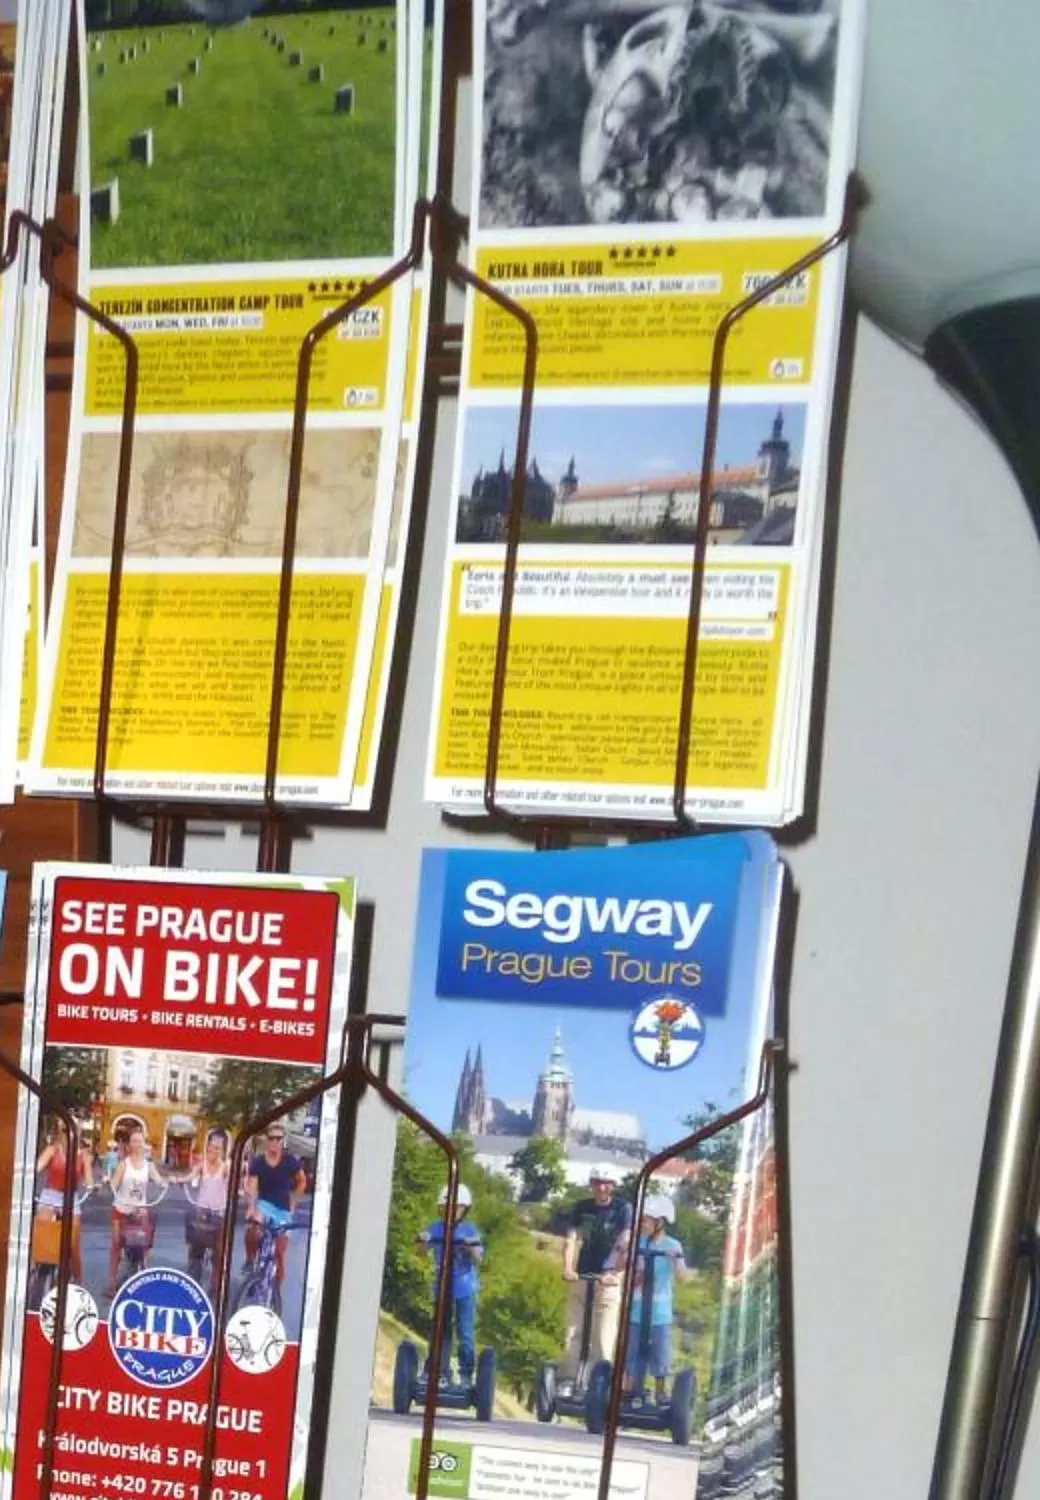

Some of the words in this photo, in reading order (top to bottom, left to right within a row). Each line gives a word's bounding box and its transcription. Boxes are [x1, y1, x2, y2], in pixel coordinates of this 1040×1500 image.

[533, 261, 566, 278] HORA
[571, 260, 603, 275] TOUR
[147, 296, 235, 315] CONCENTRATION
[239, 295, 271, 312] CAMP
[274, 294, 304, 310] TOUR
[353, 310, 380, 325] CZK
[61, 899, 127, 936] SEE
[135, 904, 284, 946] PRAGUE
[463, 879, 712, 950] Segway
[59, 942, 144, 998] ON
[163, 949, 319, 1012] BIKE!
[462, 943, 592, 983] Prague
[602, 951, 702, 987] Tours
[57, 1004, 89, 1019] BIKE
[91, 1006, 138, 1023] TOURS
[151, 1011, 183, 1027] BIKE
[186, 1014, 247, 1031] RENTALS
[259, 1020, 315, 1036] E-BIKES
[114, 1299, 209, 1340] CITY
[116, 1329, 207, 1357] BIKE
[122, 1351, 196, 1384] PRAGUE
[107, 1391, 161, 1420] BIKE
[166, 1448, 179, 1466] 5
[184, 1450, 250, 1477] Prgue
[256, 1459, 267, 1479] 1
[101, 1474, 146, 1493] +420
[151, 1479, 185, 1499] 776
